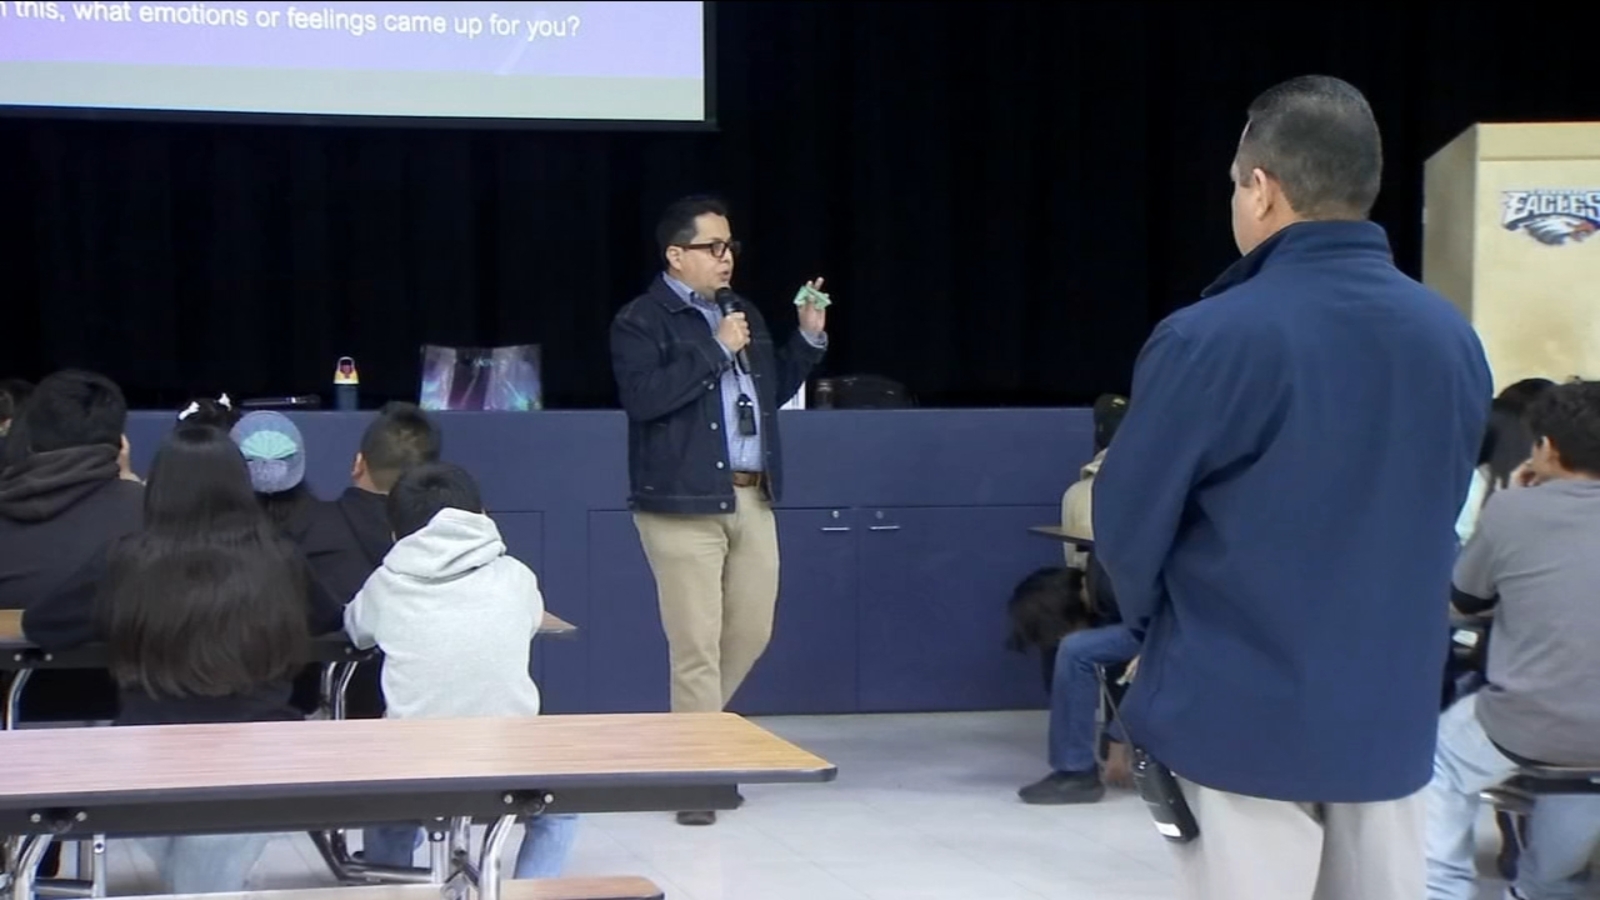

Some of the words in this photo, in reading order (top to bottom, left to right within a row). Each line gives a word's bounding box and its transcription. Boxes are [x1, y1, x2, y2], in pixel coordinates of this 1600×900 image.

[14, 2, 66, 22] this,
[74, 2, 131, 22] what
[139, 4, 248, 27] emotions
[255, 11, 280, 27] or
[287, 7, 377, 36] feelings
[384, 14, 447, 33] came
[454, 17, 483, 39] up
[489, 13, 520, 35] for
[527, 16, 580, 42] you?
[1502, 191, 1600, 222] EAGLES
